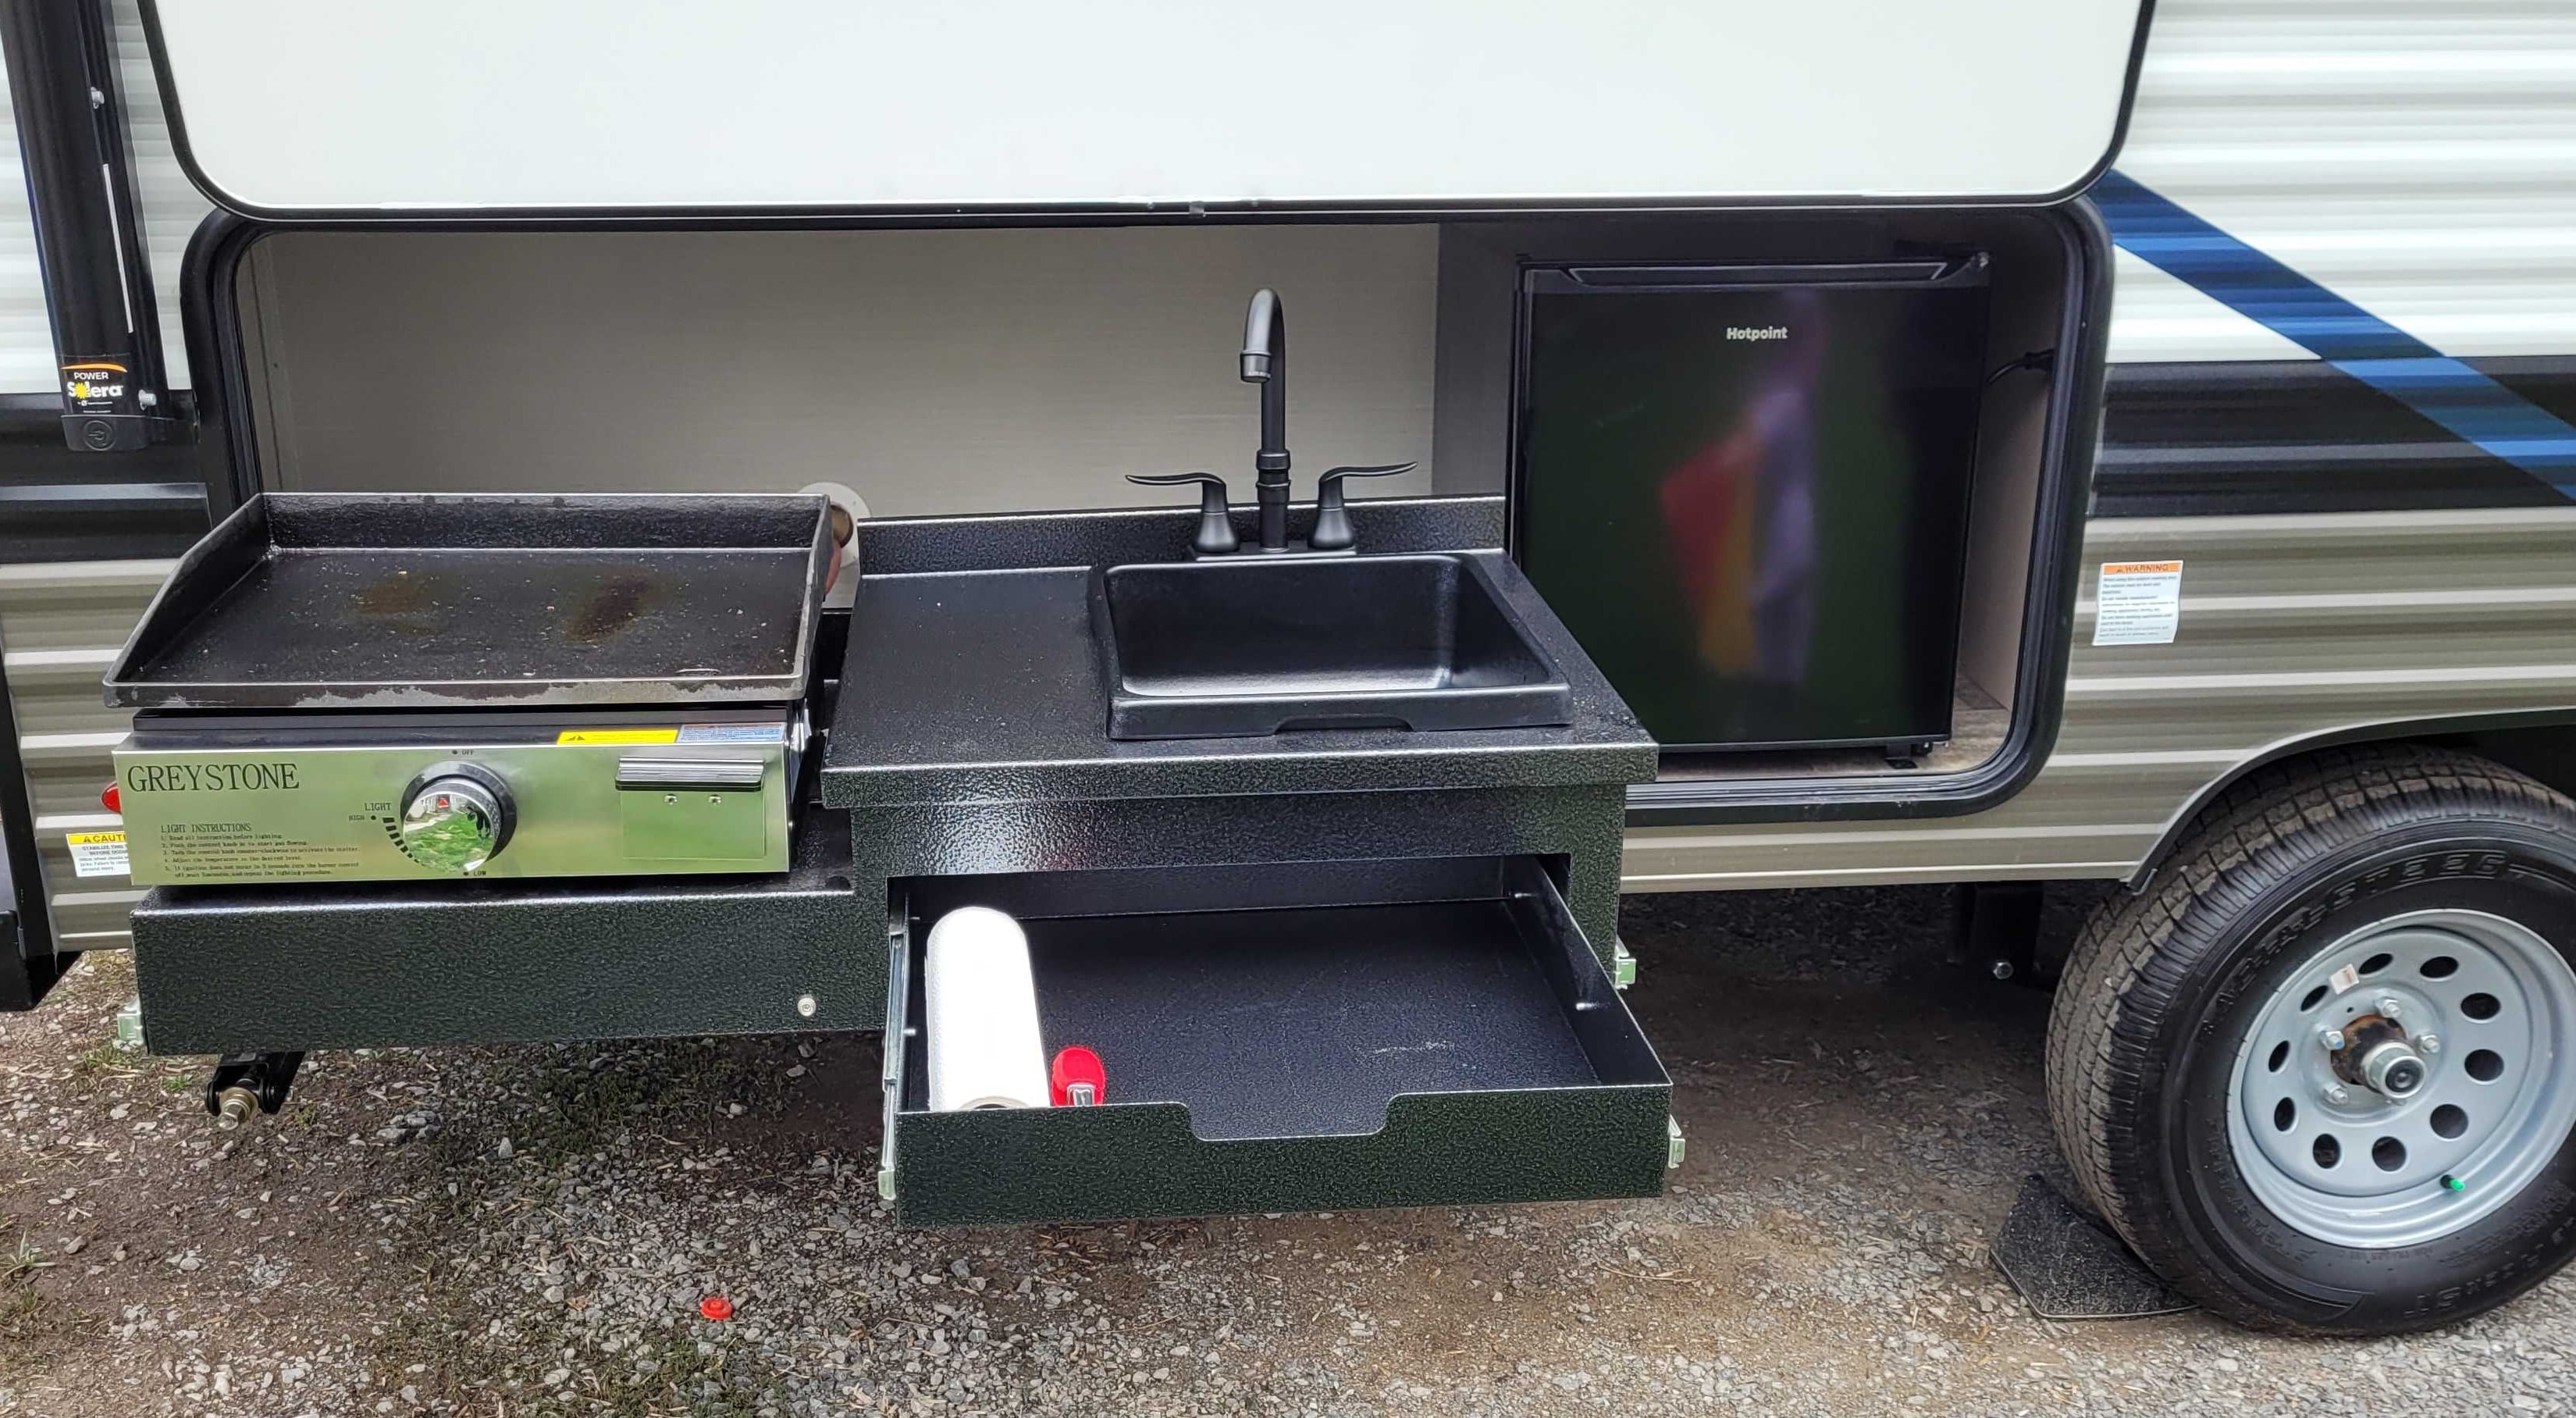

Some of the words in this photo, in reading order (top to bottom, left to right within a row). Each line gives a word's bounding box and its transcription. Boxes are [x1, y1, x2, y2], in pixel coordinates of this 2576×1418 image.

[1726, 326, 1788, 342] Hotpoint
[73, 372, 109, 380] POWER
[67, 381, 123, 399] Solera
[2125, 564, 2169, 573] WARNING
[127, 763, 300, 792] GREYSTONE
[364, 802, 392, 811] LIGHT
[161, 824, 186, 833] LIGHT
[192, 823, 251, 832] INSTRUCTIONS
[93, 834, 127, 842] CAUTI
